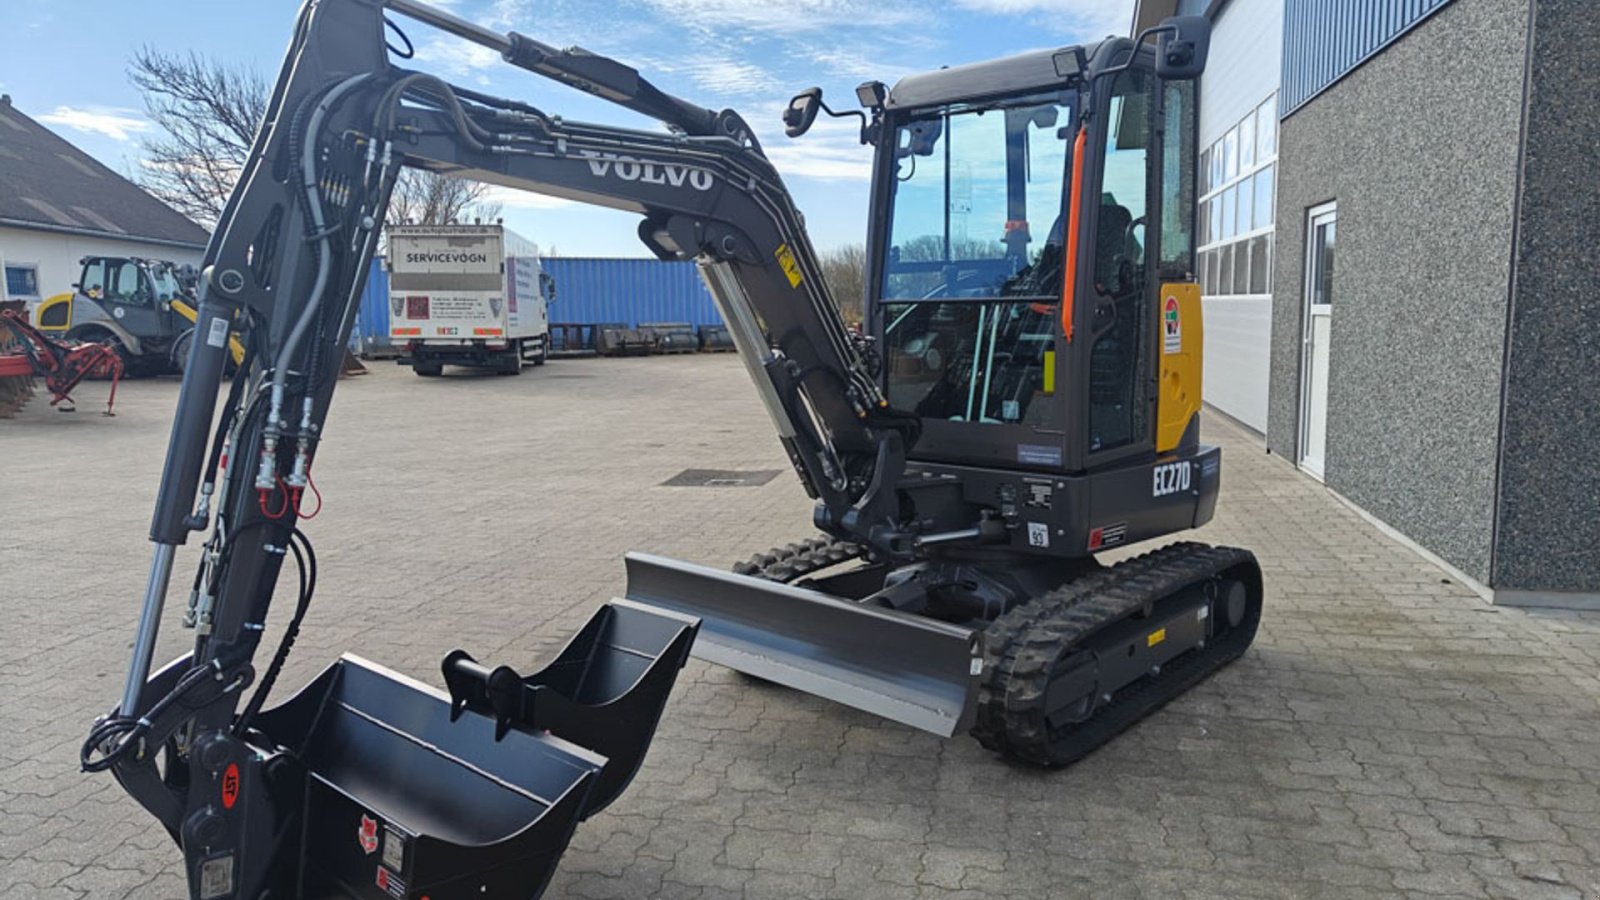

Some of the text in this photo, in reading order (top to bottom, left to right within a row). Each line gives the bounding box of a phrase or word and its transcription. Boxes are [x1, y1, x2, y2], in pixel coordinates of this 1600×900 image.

[580, 150, 714, 191] VOLVO
[406, 253, 487, 263] SERVICEVOGN
[1153, 461, 1191, 497] EC27D
